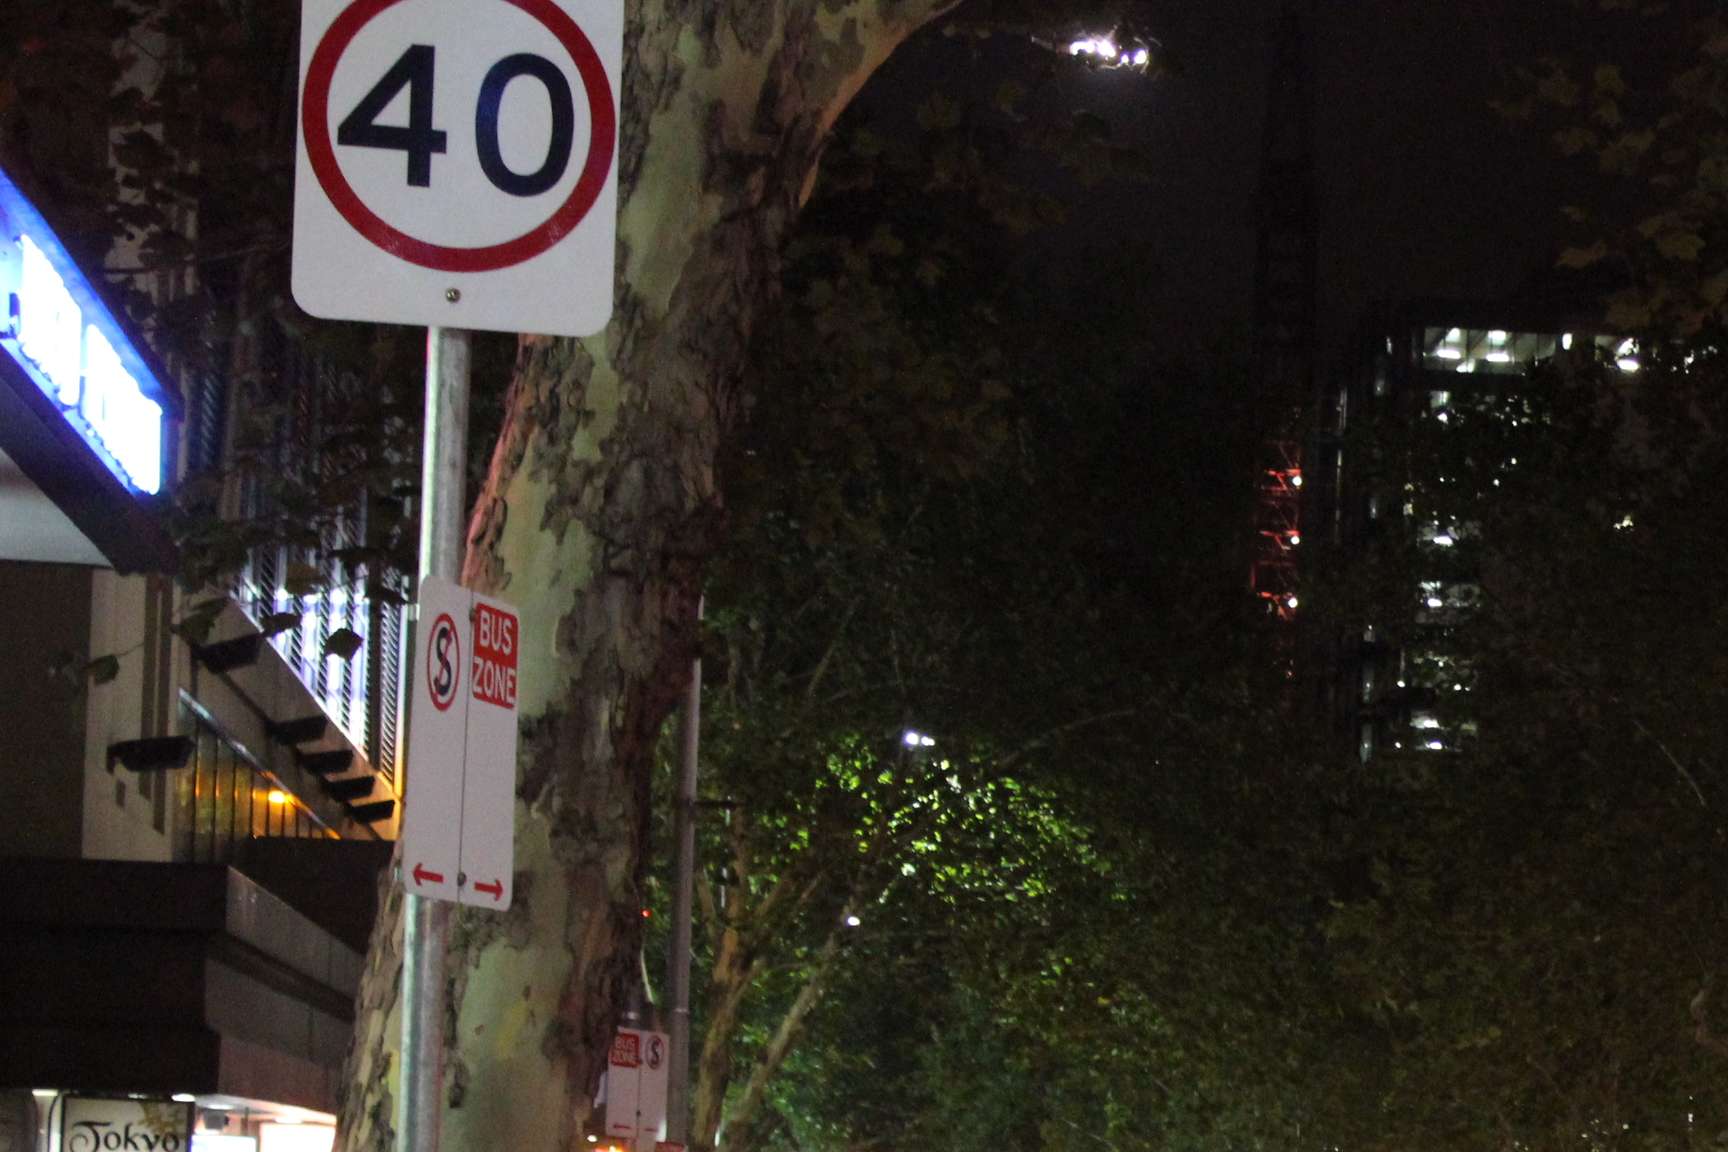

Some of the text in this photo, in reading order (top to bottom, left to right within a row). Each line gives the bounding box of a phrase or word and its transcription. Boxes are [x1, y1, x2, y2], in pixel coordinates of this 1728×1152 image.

[337, 44, 575, 198] 40
[480, 609, 512, 656] BUS
[473, 655, 516, 704] ZONE
[615, 1035, 636, 1050] BUS
